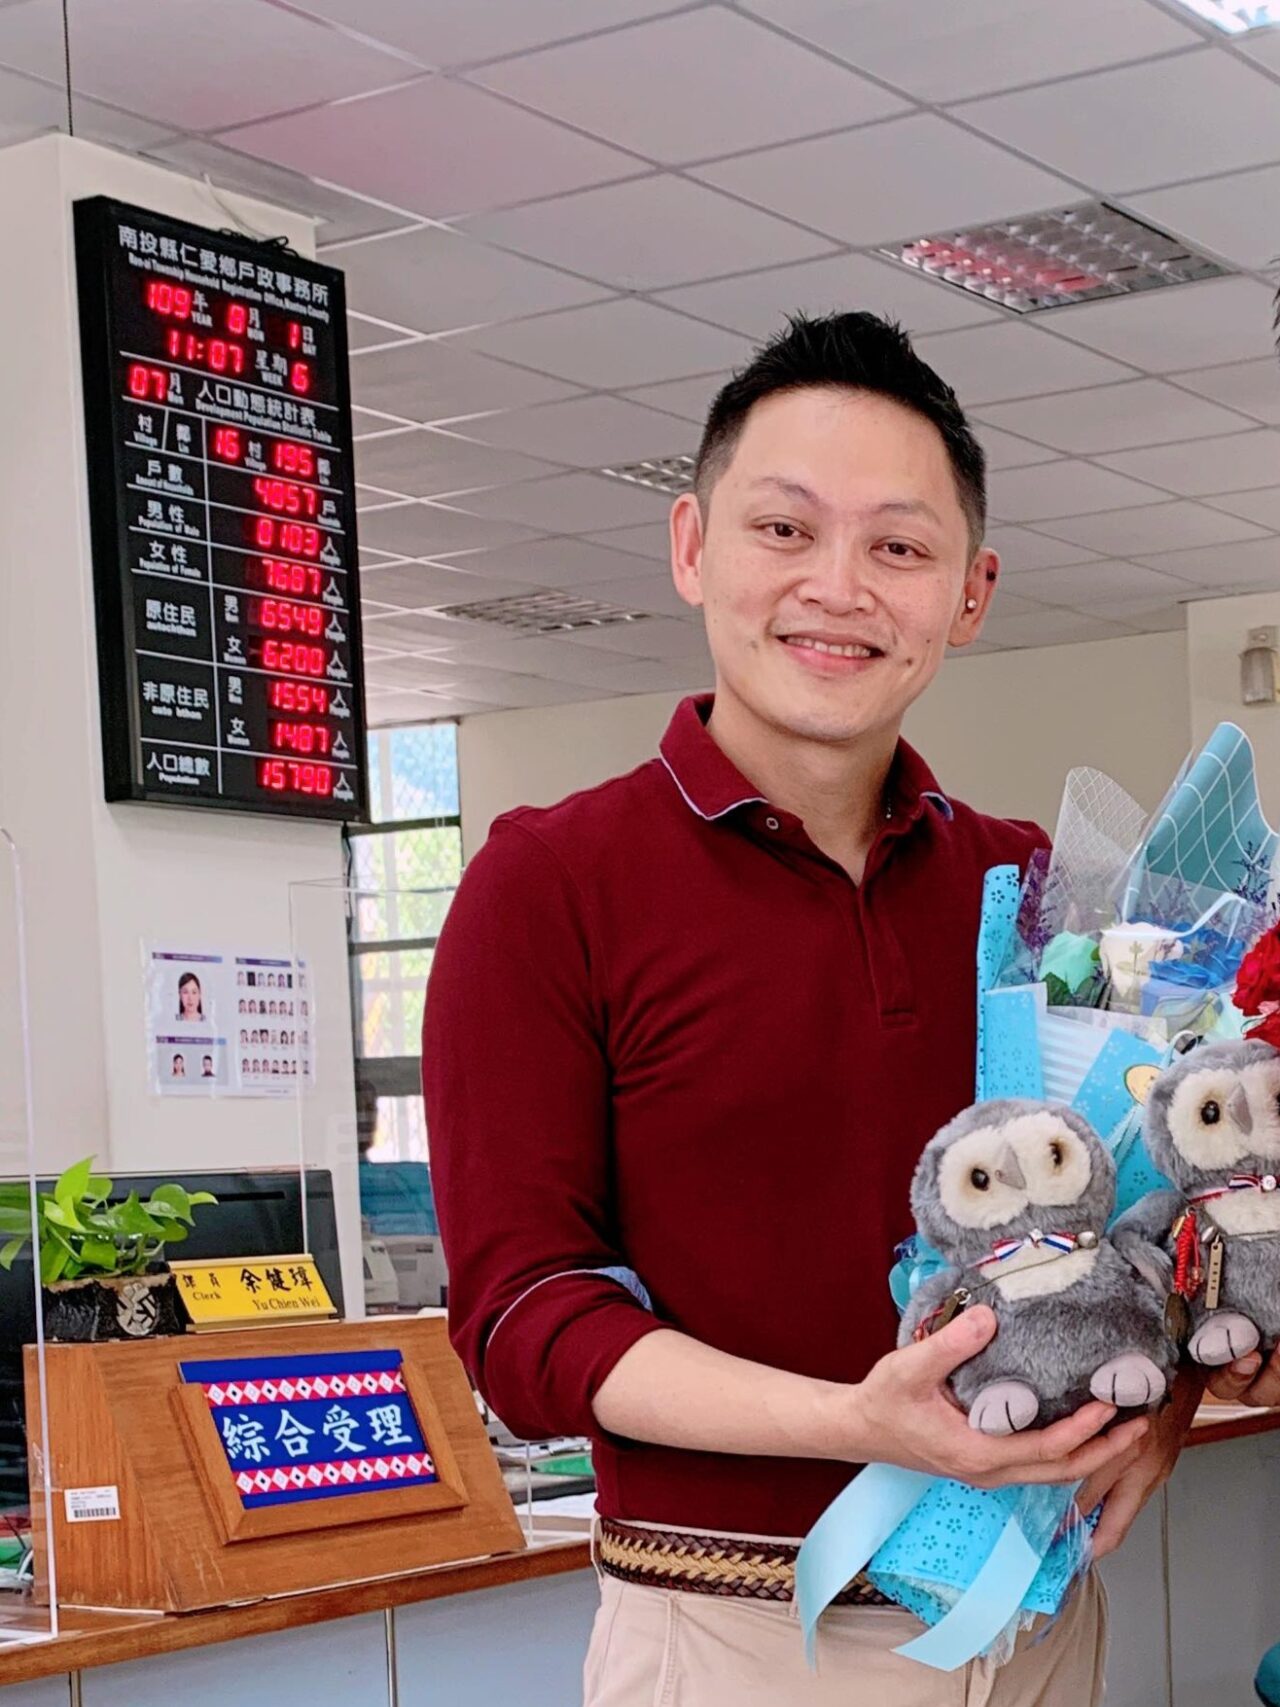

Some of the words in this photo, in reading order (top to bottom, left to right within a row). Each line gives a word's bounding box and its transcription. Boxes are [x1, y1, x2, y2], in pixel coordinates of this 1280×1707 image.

[118, 225, 329, 307] 南投縣仁愛鄉戶政事務所
[147, 282, 191, 318] 109
[193, 290, 208, 312] 年
[248, 307, 260, 328] 月
[302, 326, 314, 342] 日
[169, 330, 243, 373] 11:07
[255, 350, 288, 376] 星期
[292, 362, 309, 392] 6
[131, 366, 165, 400] 07
[170, 372, 181, 394] 月
[198, 380, 316, 427] 人口動態統計表
[216, 430, 239, 459] 16
[275, 444, 313, 476] 195
[147, 500, 184, 524] 男性
[148, 540, 188, 564] 女性
[146, 598, 196, 627] 原住民
[224, 594, 239, 614] 男
[262, 600, 322, 636] 6549
[226, 635, 242, 654] 女
[263, 640, 324, 674] 6200
[142, 680, 210, 710] 非原住民
[228, 676, 243, 695] 男
[273, 682, 326, 713] 1554
[230, 717, 246, 736] 女
[146, 752, 210, 776] 人口總數
[262, 762, 331, 795] 15790
[192, 1290, 222, 1302] Clerk
[221, 1403, 414, 1463] 綜合受理
